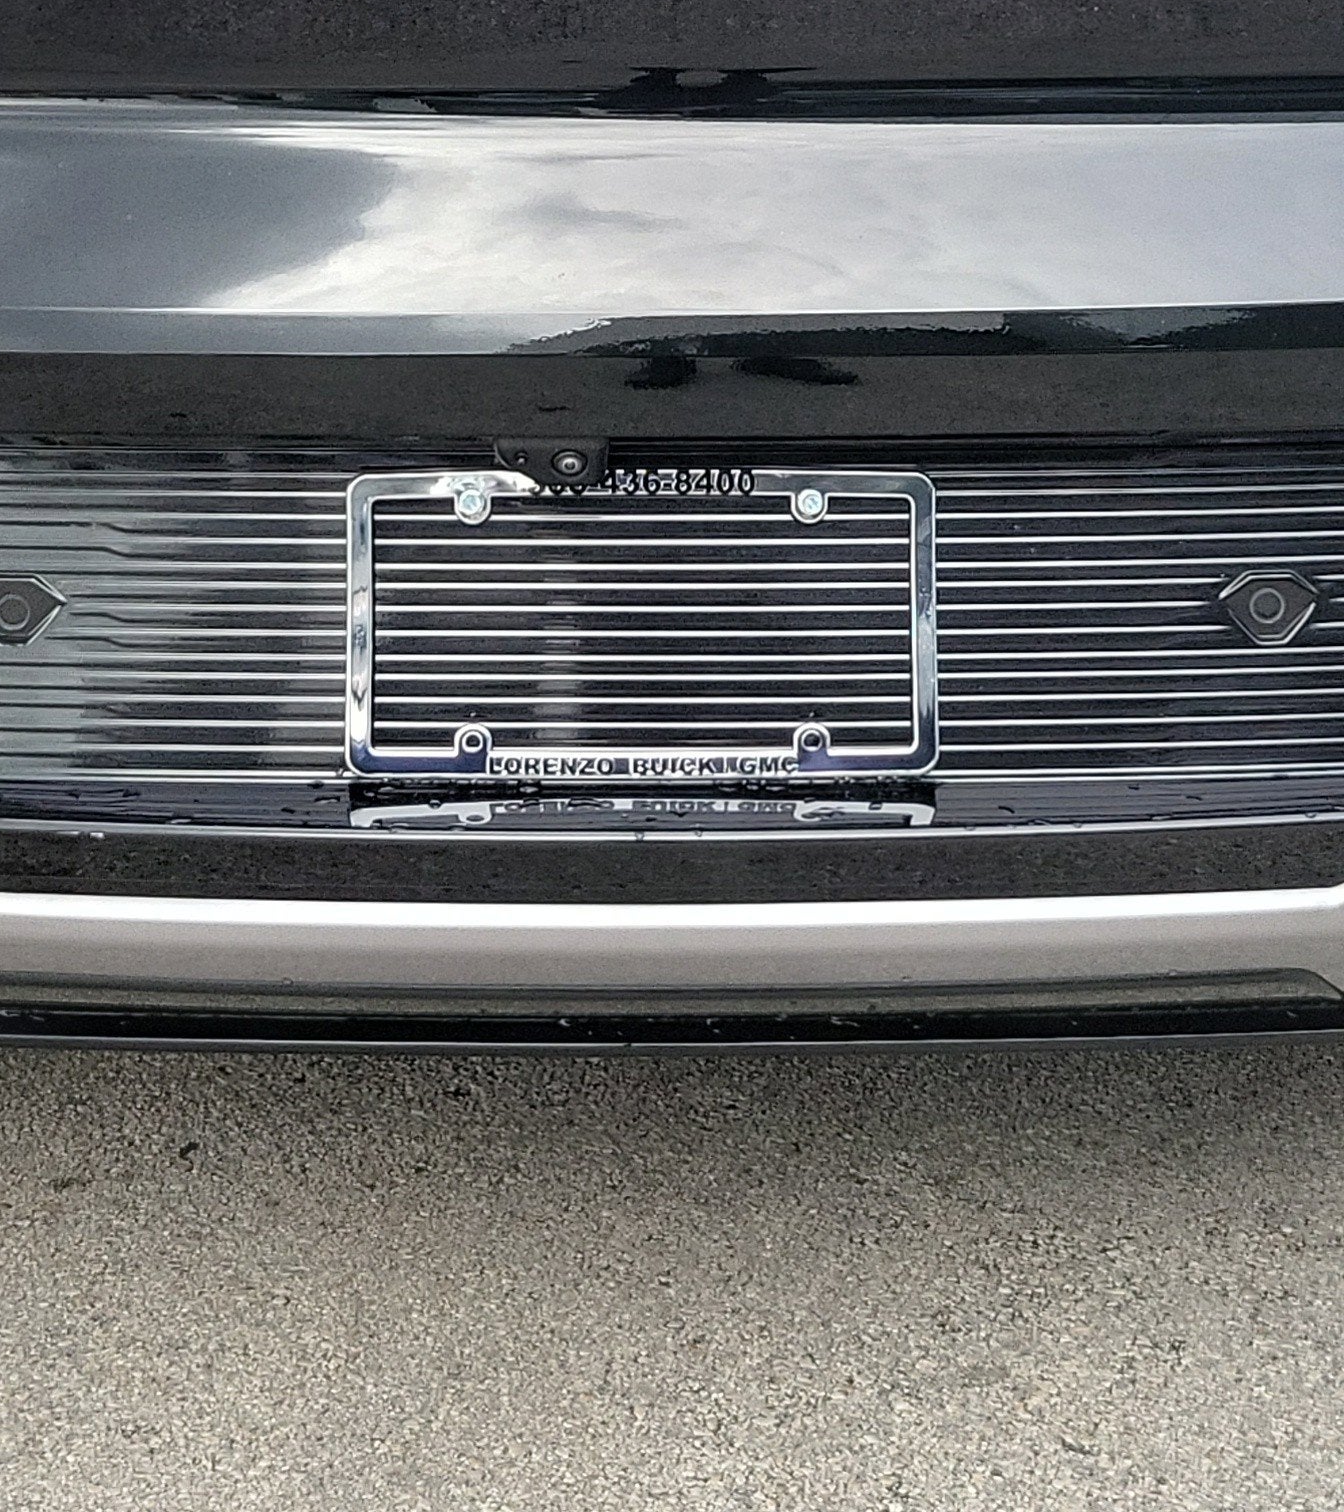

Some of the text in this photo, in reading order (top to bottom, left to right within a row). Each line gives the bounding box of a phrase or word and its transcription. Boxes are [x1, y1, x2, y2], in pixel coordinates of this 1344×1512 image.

[488, 756, 614, 775] LORENZO
[632, 756, 715, 775] BUICK
[737, 755, 799, 774] GMC
